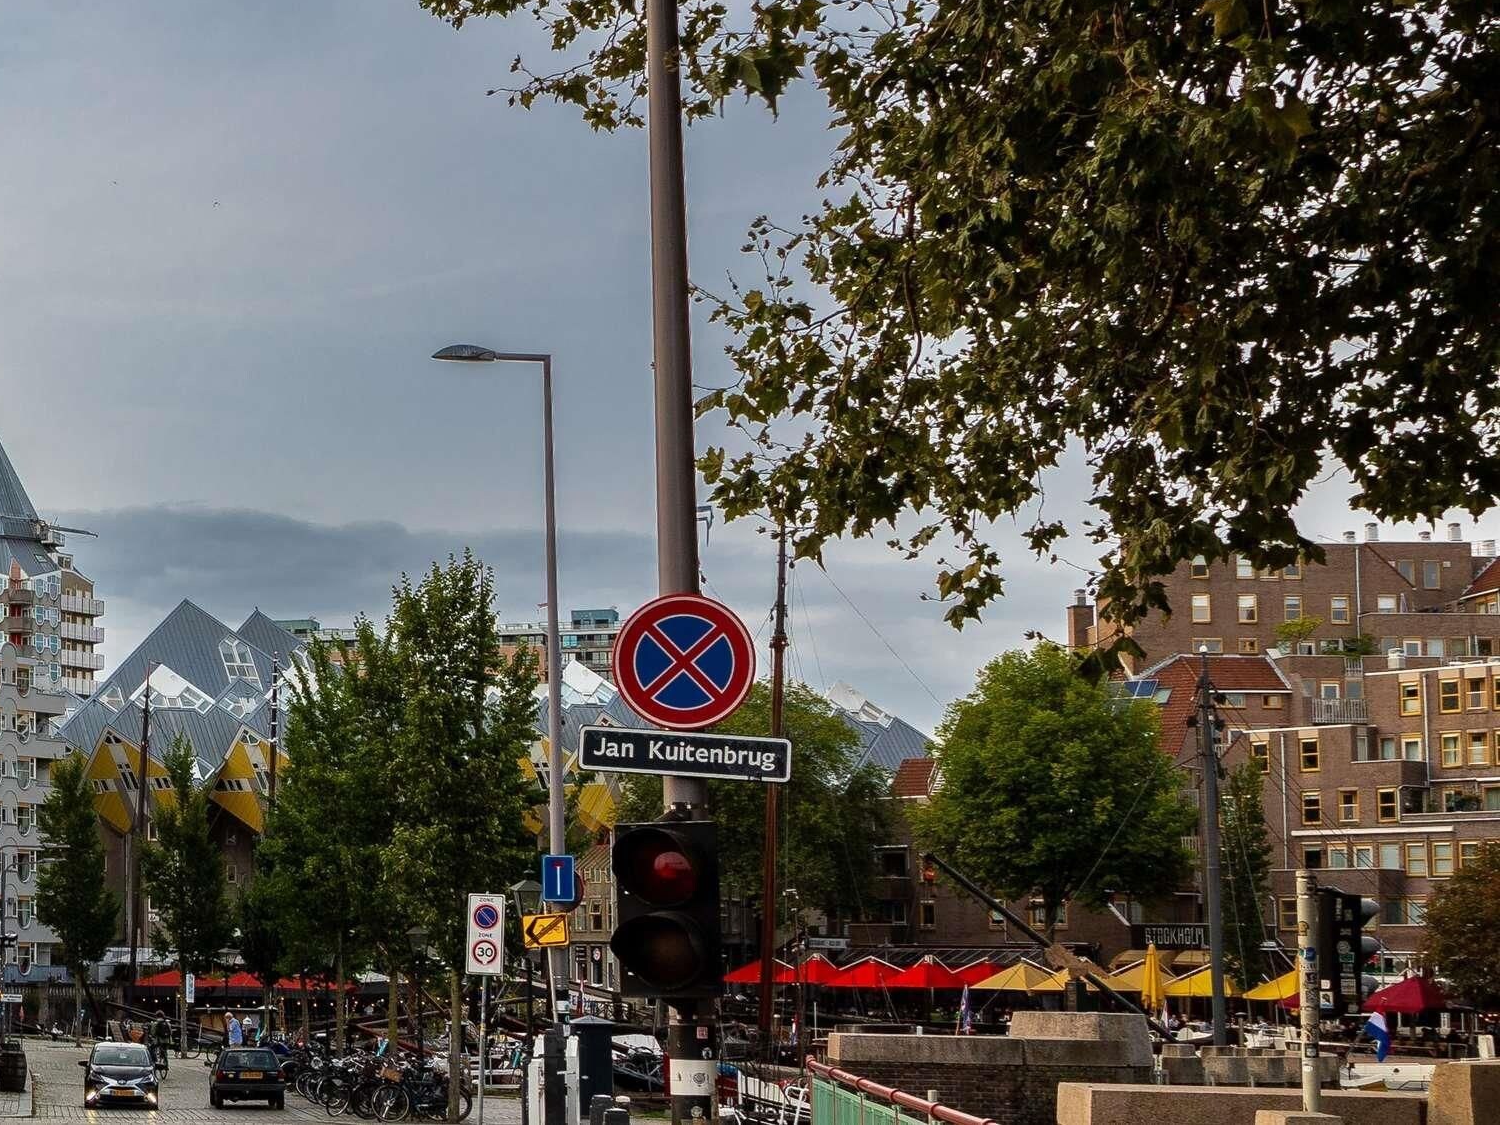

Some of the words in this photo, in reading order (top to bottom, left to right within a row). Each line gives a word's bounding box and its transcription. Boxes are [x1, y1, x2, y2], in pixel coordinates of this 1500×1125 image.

[593, 737, 635, 758] Jan
[648, 739, 777, 772] Kuitenbrug
[1144, 926, 1205, 945] STOCKHOLM
[476, 947, 494, 958] 30
